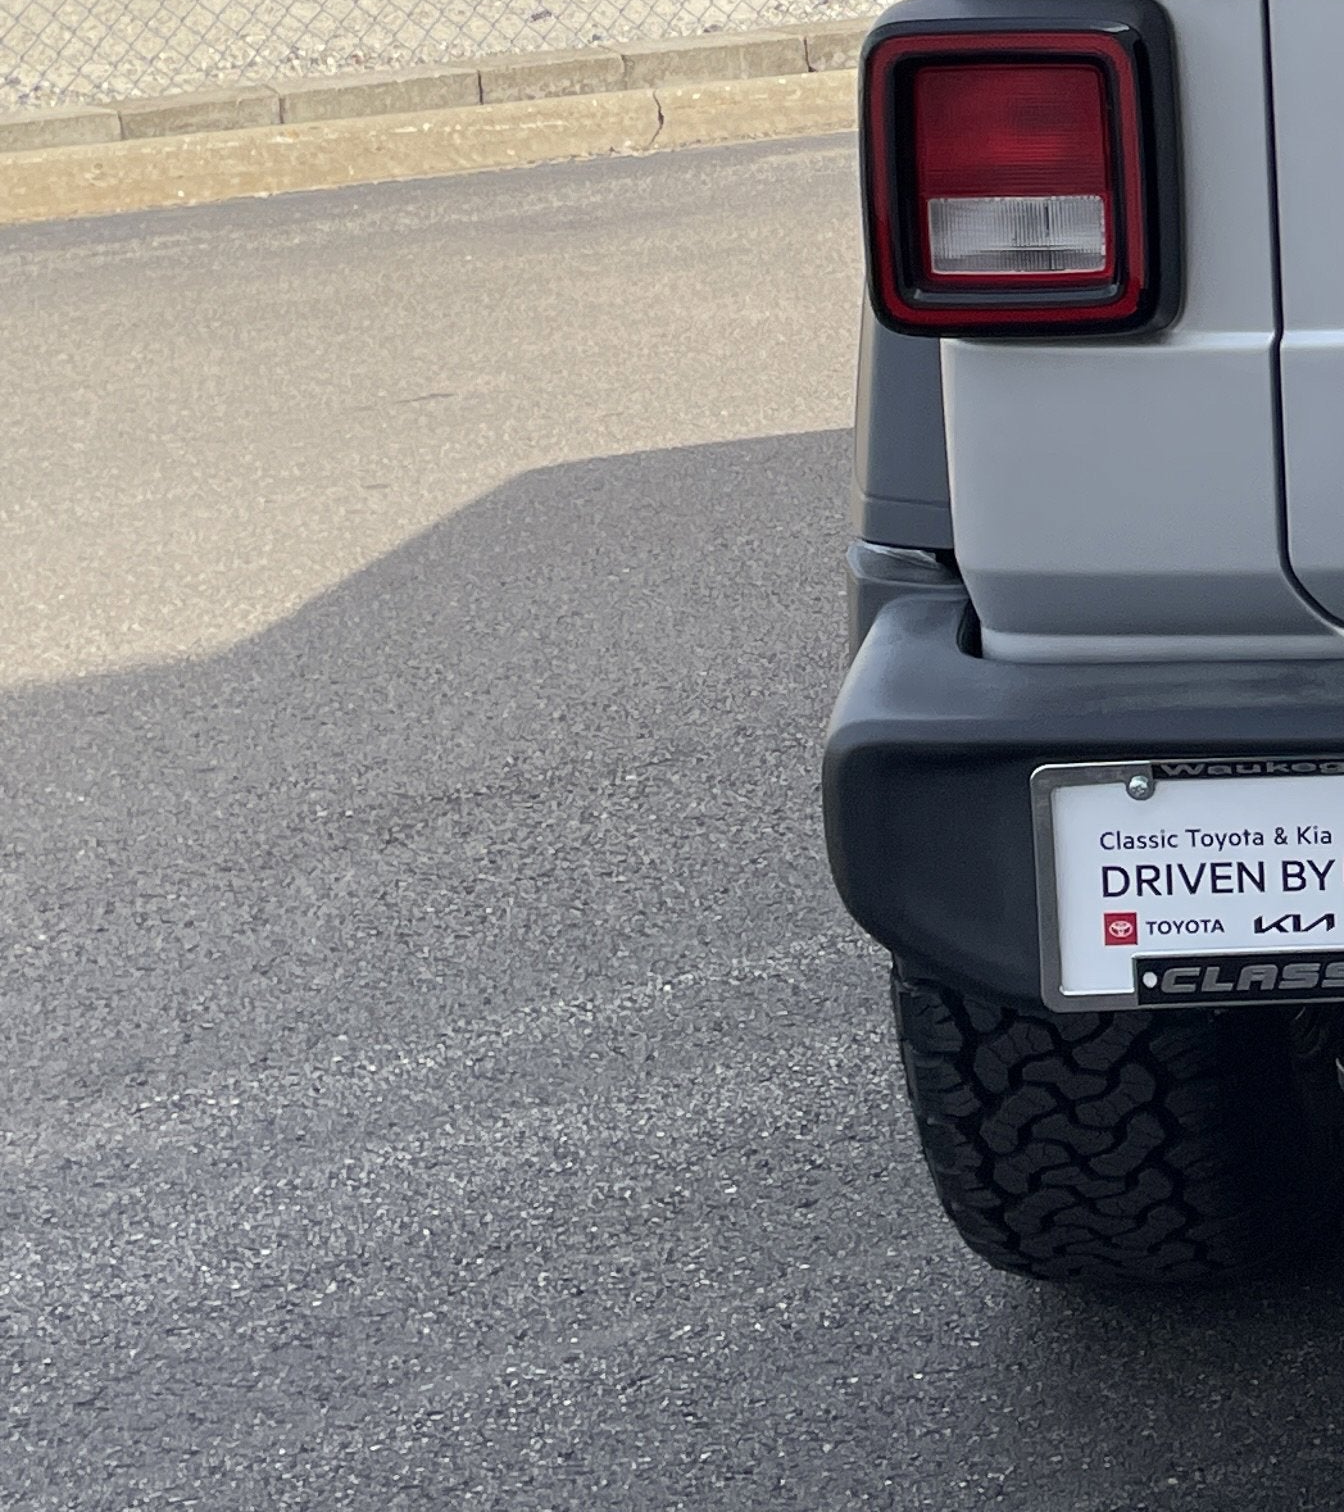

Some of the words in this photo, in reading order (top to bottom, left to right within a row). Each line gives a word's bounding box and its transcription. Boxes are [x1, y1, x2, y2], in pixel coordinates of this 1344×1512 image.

[1099, 829, 1178, 851] Classic
[1186, 828, 1265, 852] Toyota
[1275, 828, 1288, 846] &
[1297, 825, 1333, 845] Kia
[1101, 860, 1265, 898] DRIVEN
[1281, 859, 1335, 892] BY
[1146, 919, 1225, 936] TOYOTA
